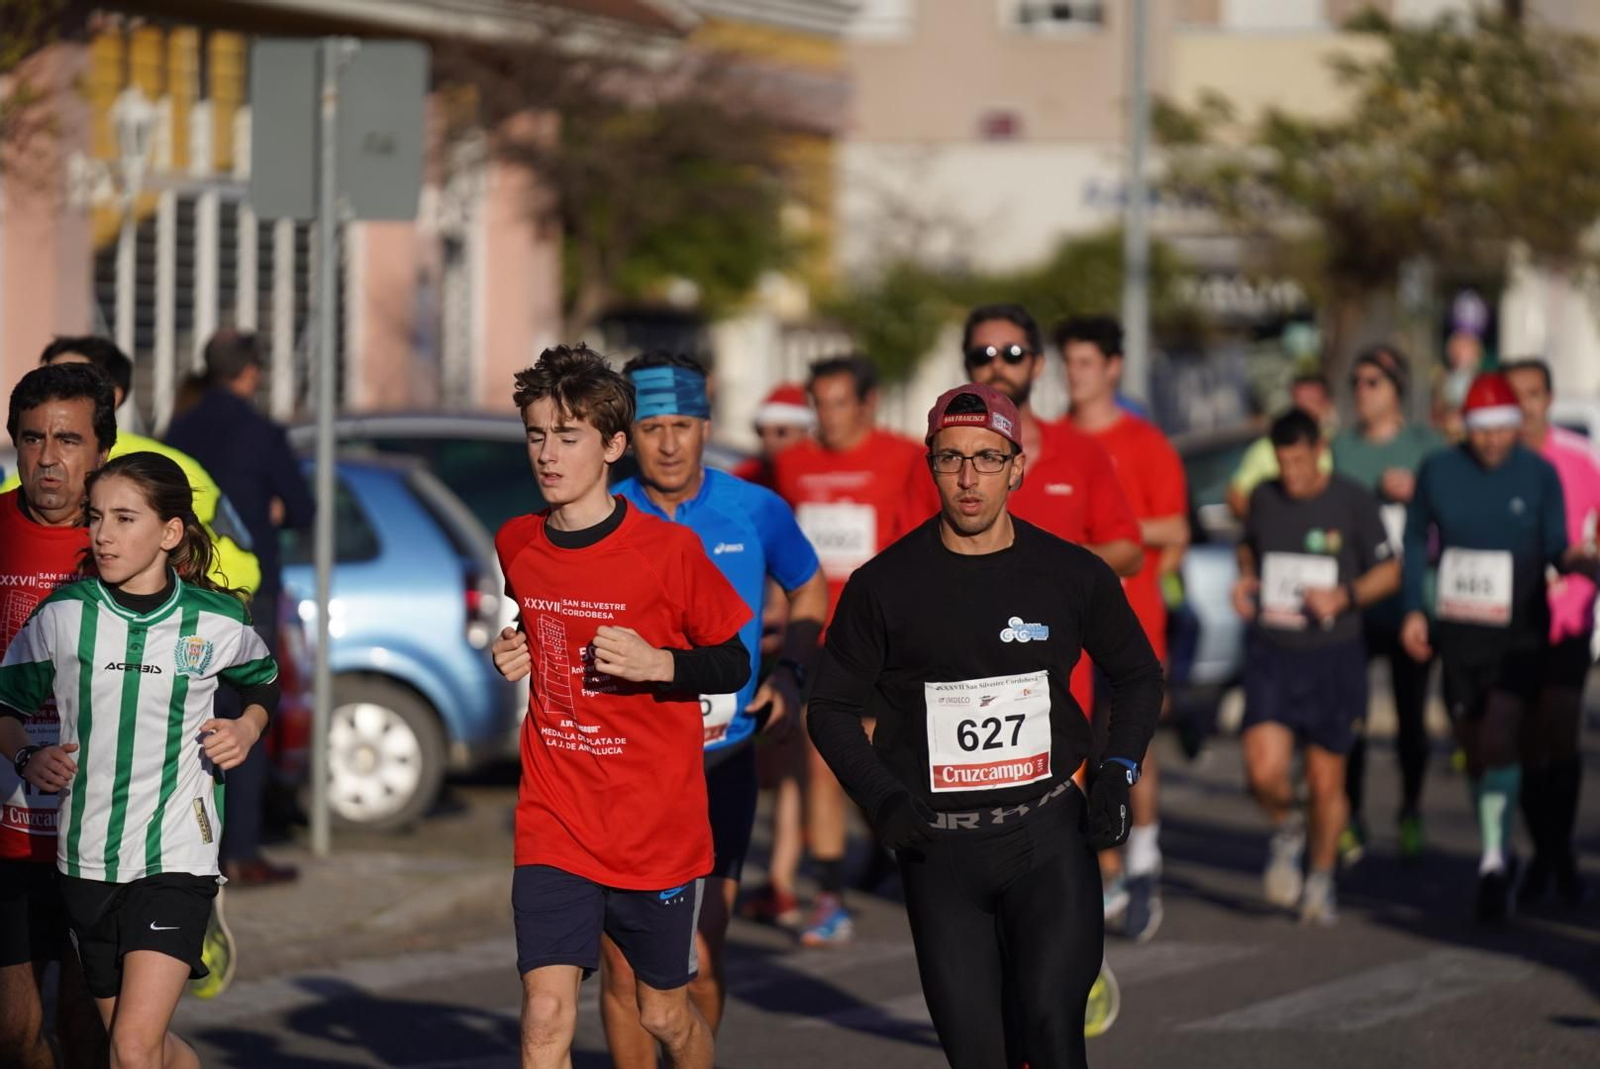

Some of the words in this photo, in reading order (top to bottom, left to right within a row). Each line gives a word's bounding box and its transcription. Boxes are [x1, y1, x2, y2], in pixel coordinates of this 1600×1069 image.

[955, 414, 986, 422] FRANCISCO
[38, 572, 57, 580] SAN
[523, 597, 560, 613] XXXVII
[562, 599, 579, 608] SAN
[580, 600, 627, 611] SILVESTRE
[562, 608, 615, 620] CORDOBESA
[104, 661, 162, 674] ACERBIS
[541, 727, 576, 741] MEDALLA
[614, 737, 627, 745] DE
[956, 713, 1026, 753] 627
[546, 738, 557, 746] LA
[558, 740, 565, 748] J.
[566, 741, 577, 751] DE
[577, 743, 623, 756] ANDALUCIA
[942, 762, 1034, 783] Cruzcampo
